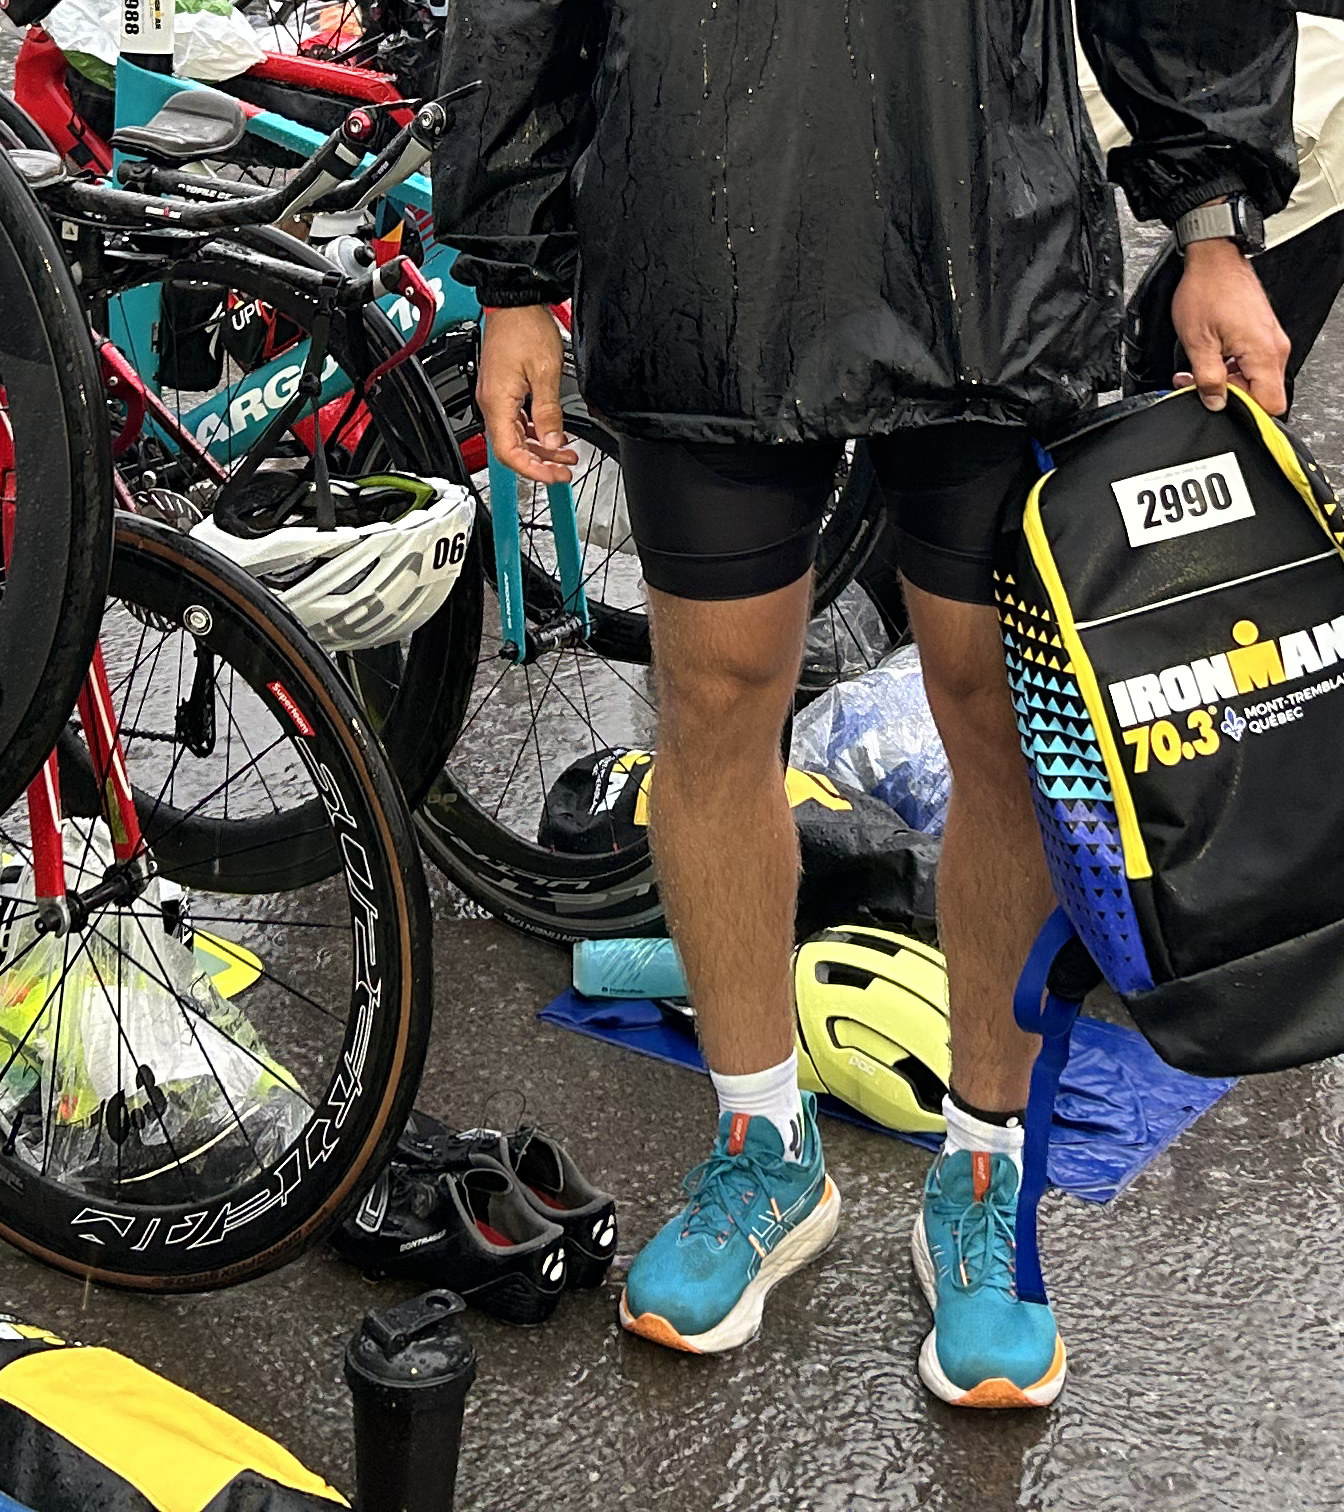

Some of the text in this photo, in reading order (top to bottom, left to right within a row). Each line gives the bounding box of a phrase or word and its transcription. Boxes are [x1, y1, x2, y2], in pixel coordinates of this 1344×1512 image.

[1136, 472, 1233, 530] 2990
[271, 682, 311, 735] Superteam
[399, 1229, 447, 1254] BONTRAGER
